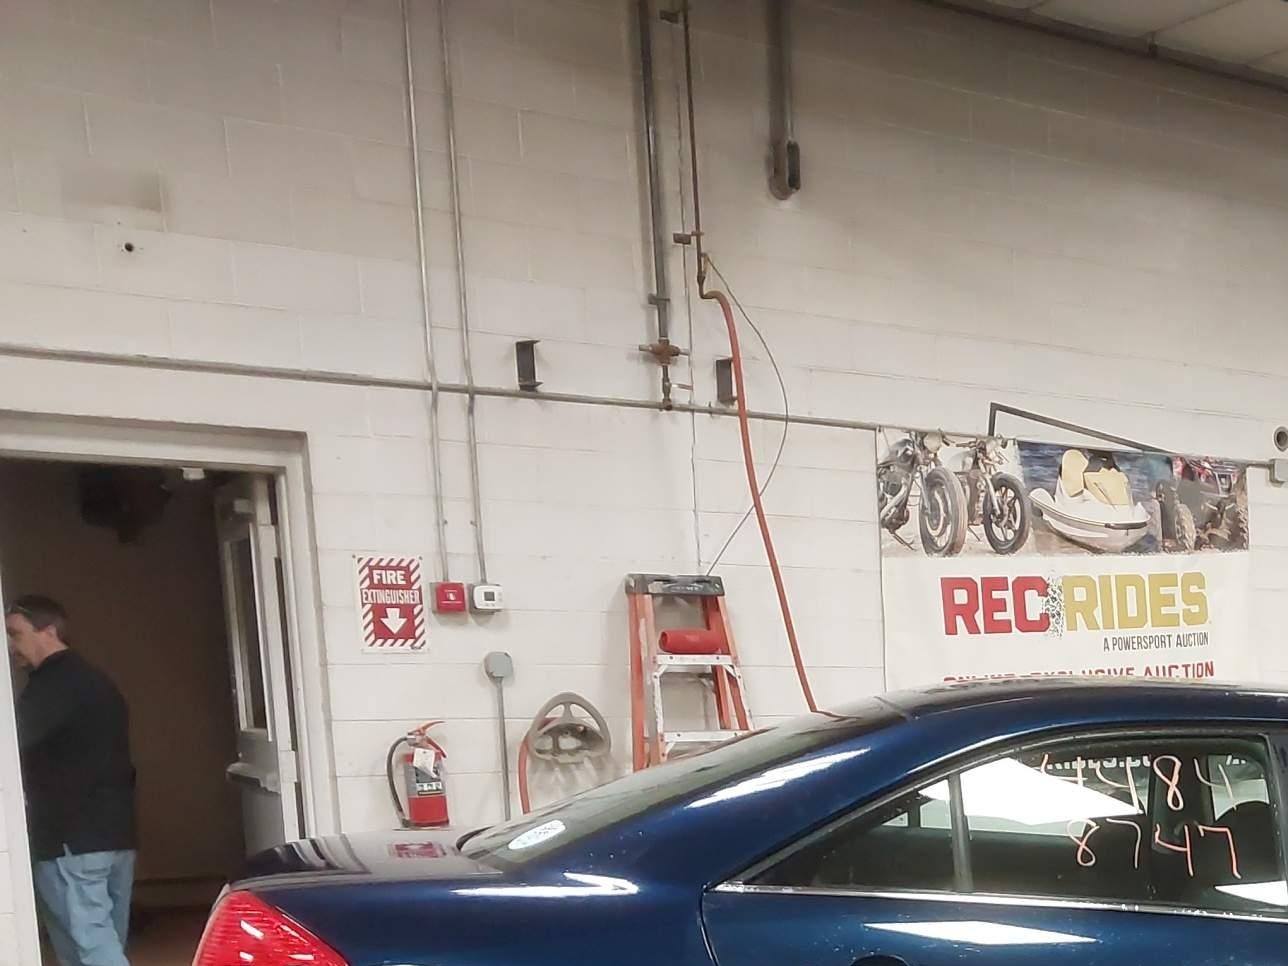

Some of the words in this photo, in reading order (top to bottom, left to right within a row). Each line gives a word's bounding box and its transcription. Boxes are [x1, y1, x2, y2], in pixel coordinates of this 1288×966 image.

[372, 569, 407, 585] FIRE
[363, 588, 420, 604] EXTINGUISHER
[940, 576, 1051, 635] REC
[1063, 571, 1209, 632] RIDES
[1103, 637, 1110, 652] A
[1112, 634, 1172, 651] POWERSPORT
[1176, 631, 1209, 648] AUCTION
[1066, 817, 1241, 879] 8747
